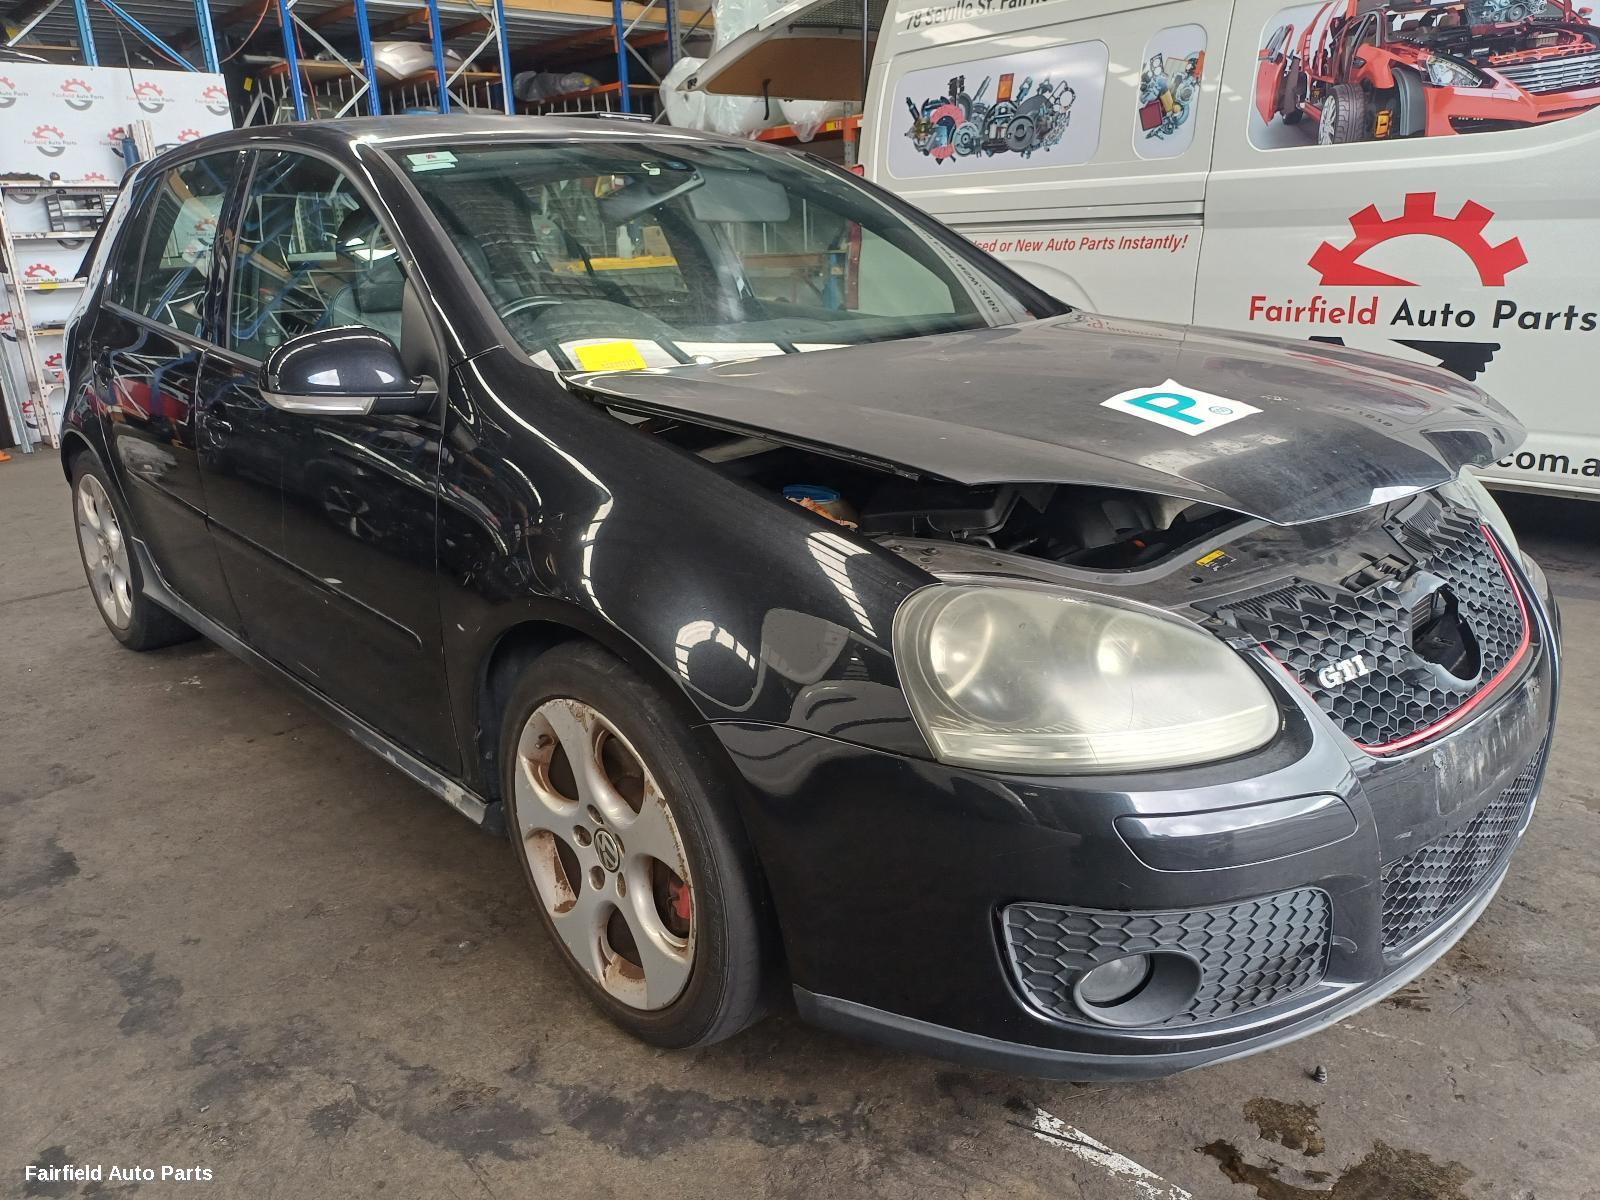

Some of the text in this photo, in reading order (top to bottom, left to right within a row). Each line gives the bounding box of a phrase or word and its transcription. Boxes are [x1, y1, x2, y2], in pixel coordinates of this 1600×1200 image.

[1000, 241, 1013, 252] or
[1015, 239, 1043, 252] New
[1046, 238, 1076, 251] Auto
[1079, 236, 1116, 251] Parts
[1118, 234, 1189, 253] Instantly!
[1249, 296, 1598, 332] Fairfield Auto Parts
[1122, 392, 1205, 425] P
[1319, 654, 1369, 689] GTI
